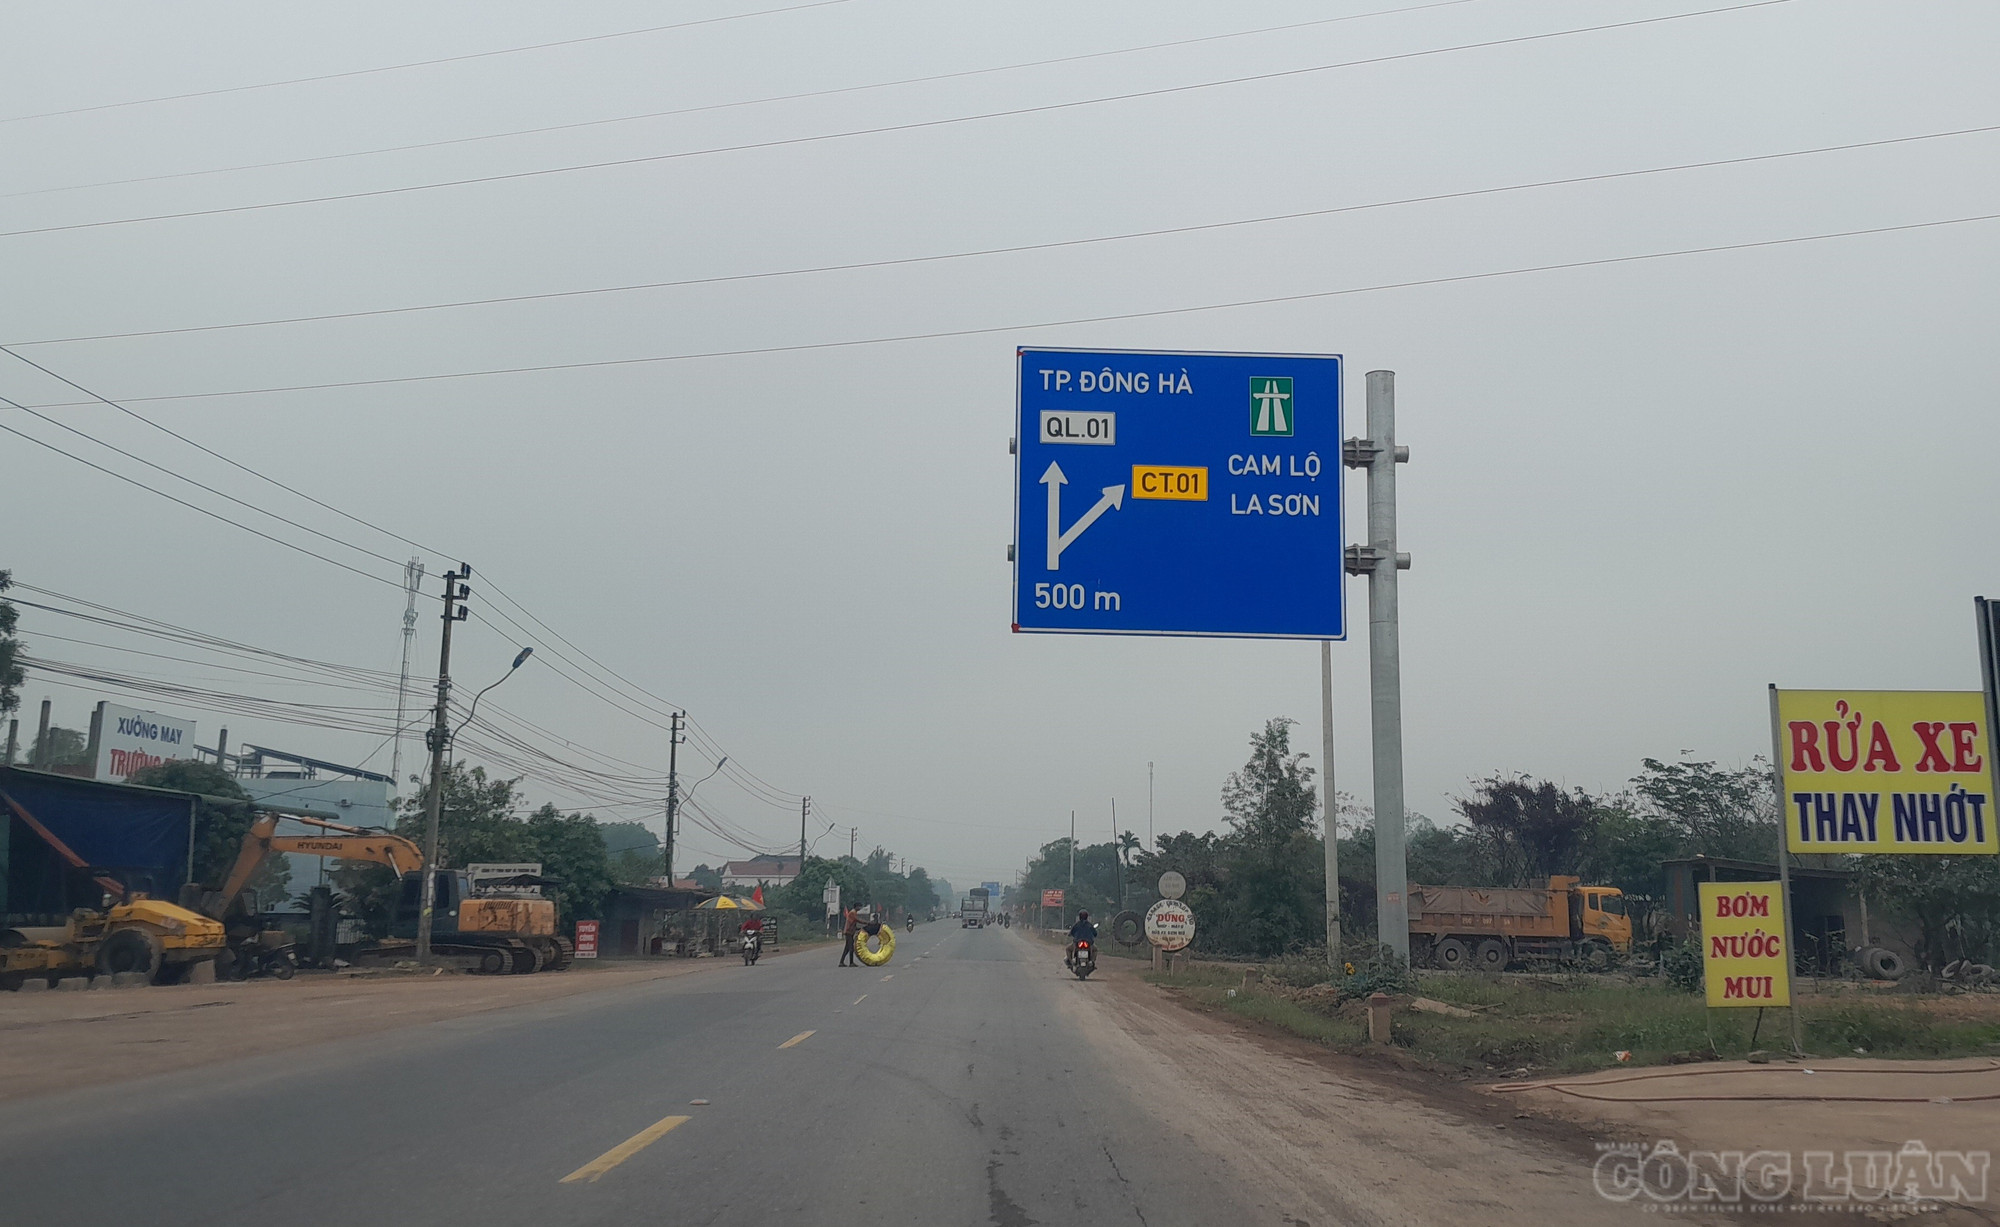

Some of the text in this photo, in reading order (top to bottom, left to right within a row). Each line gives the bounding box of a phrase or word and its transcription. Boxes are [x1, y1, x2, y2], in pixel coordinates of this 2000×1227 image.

[1039, 367, 1193, 395] TP. ĐÔNG HÀ
[1046, 416, 1109, 439] QL.01
[1228, 452, 1321, 482] CAM LỘ
[1141, 472, 1199, 494] CT.01
[1231, 493, 1320, 516] LA SƠN
[1035, 583, 1121, 611] 500 m
[117, 715, 183, 745] XƯỞNG MAY
[1788, 699, 1982, 773] RỬA XE
[1793, 783, 1986, 843] THAY NHỚT
[297, 842, 343, 851] HYUNDAI
[1716, 891, 1769, 917] BƠM
[1711, 928, 1780, 958] NƯỚC
[1723, 976, 1773, 999] MUI
